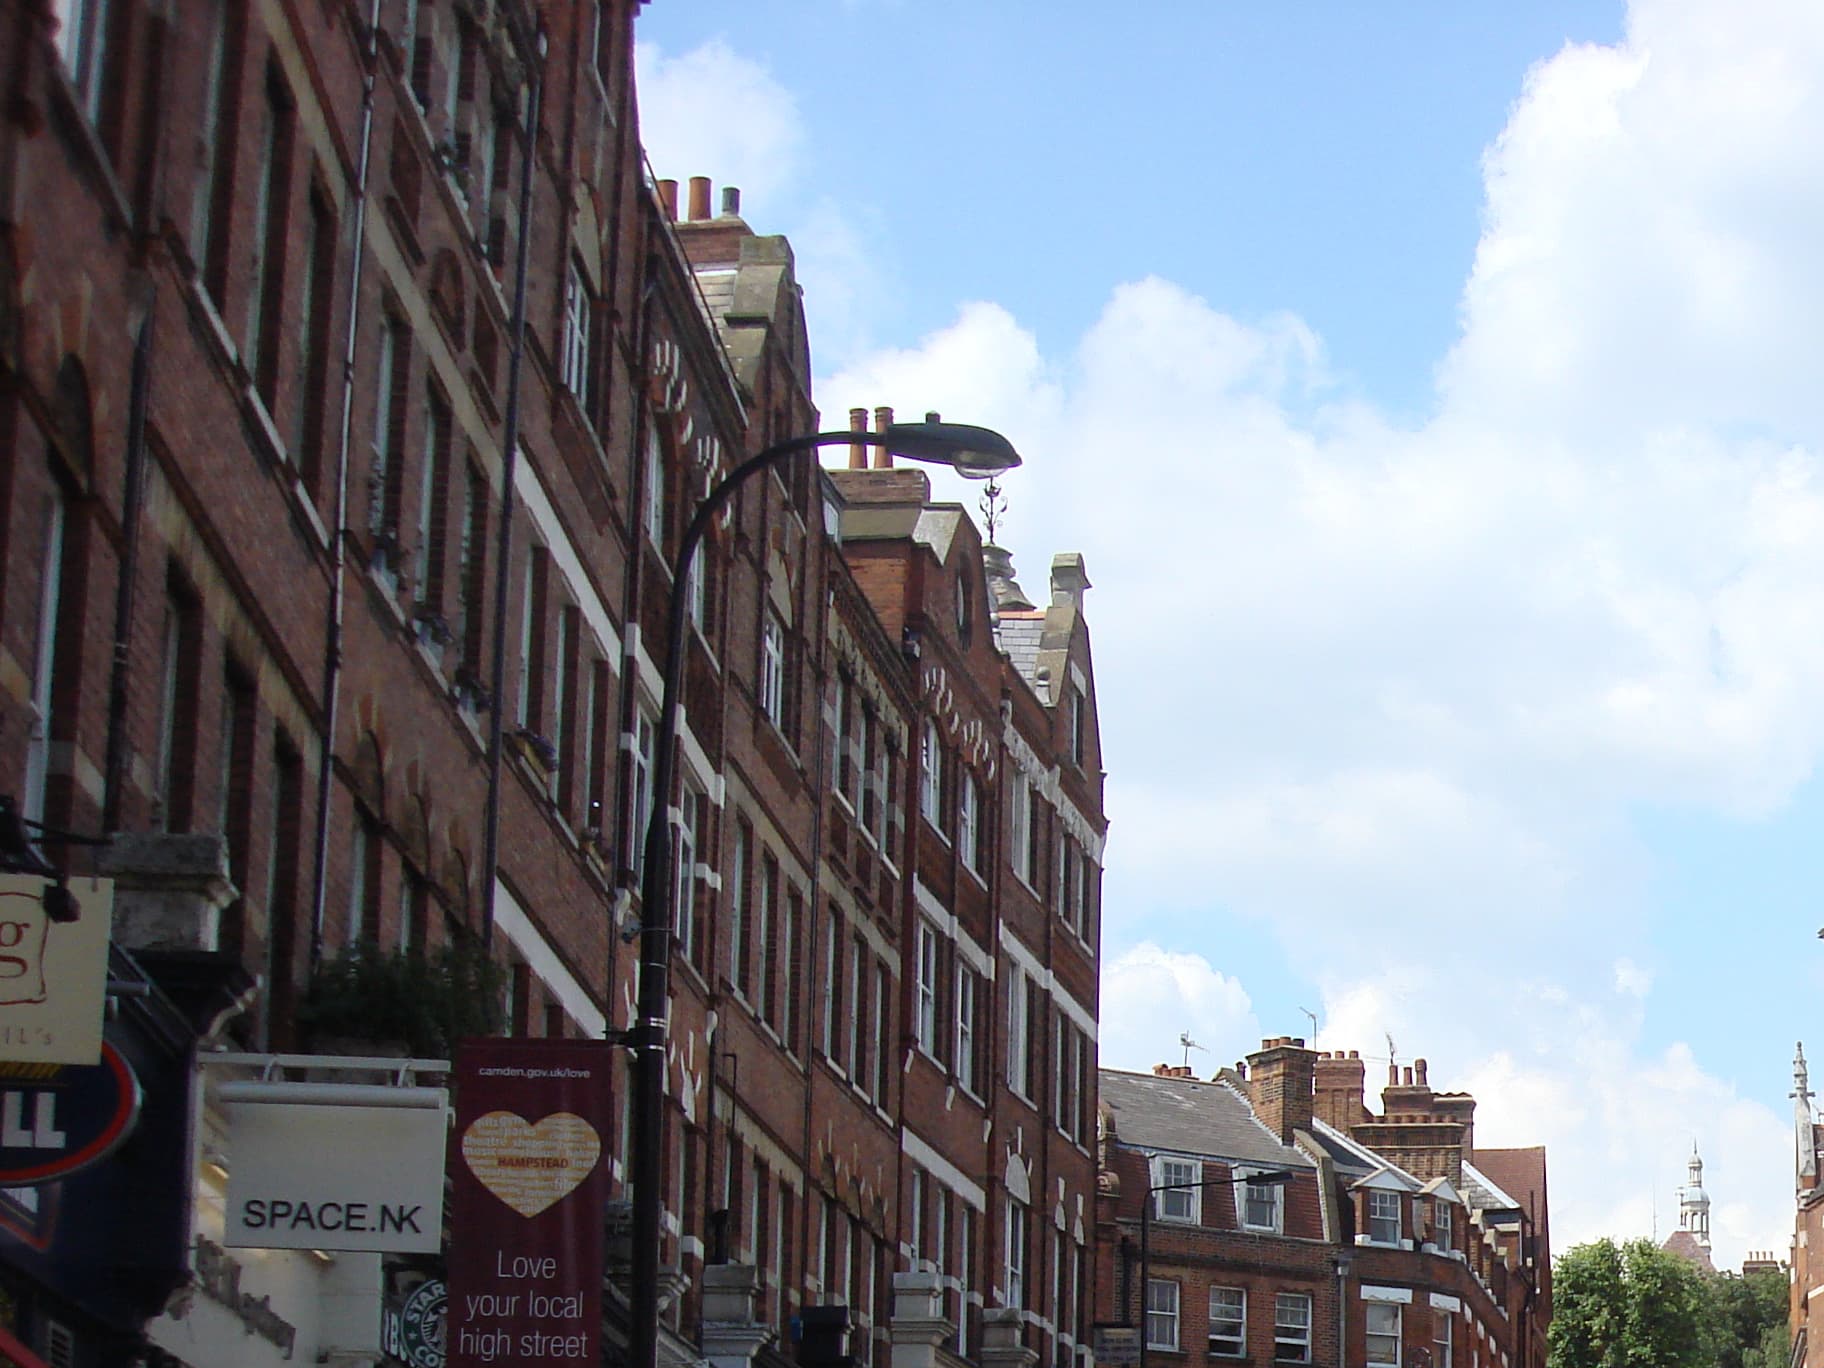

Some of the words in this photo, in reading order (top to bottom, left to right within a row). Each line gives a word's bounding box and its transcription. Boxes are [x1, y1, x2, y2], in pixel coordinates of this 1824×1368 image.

[479, 1067, 591, 1078] camden.gov.uk/love
[1, 1091, 66, 1148] LL
[498, 1157, 569, 1168] HAMPSTEAD
[497, 1250, 556, 1279] Love
[466, 1295, 520, 1321] your
[529, 1290, 583, 1319] local
[460, 1328, 511, 1361] high
[520, 1331, 588, 1358] street
